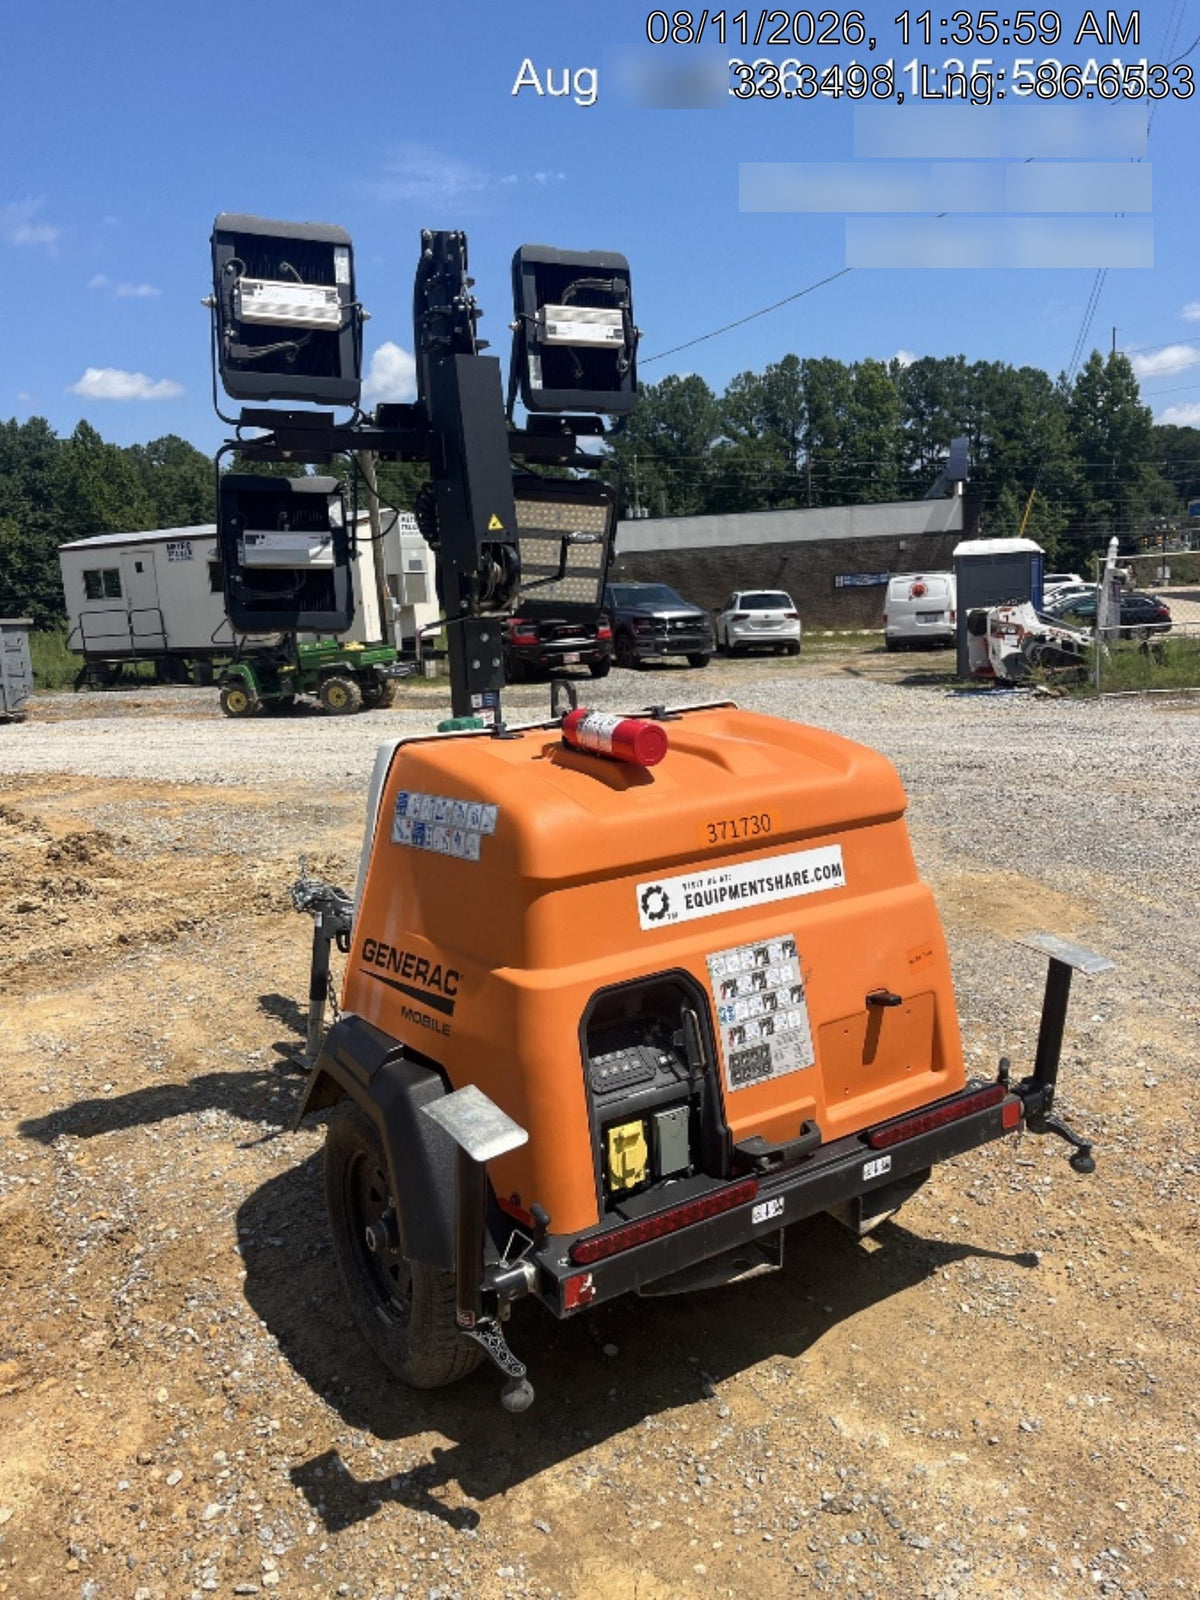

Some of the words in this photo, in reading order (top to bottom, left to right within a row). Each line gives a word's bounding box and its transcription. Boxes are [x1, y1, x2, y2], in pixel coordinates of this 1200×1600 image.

[706, 813, 772, 844] 371730
[684, 862, 842, 910] EQUIPMENTSHARE.COM
[362, 938, 460, 996] GENERAC
[401, 1005, 452, 1037] MOBILE
